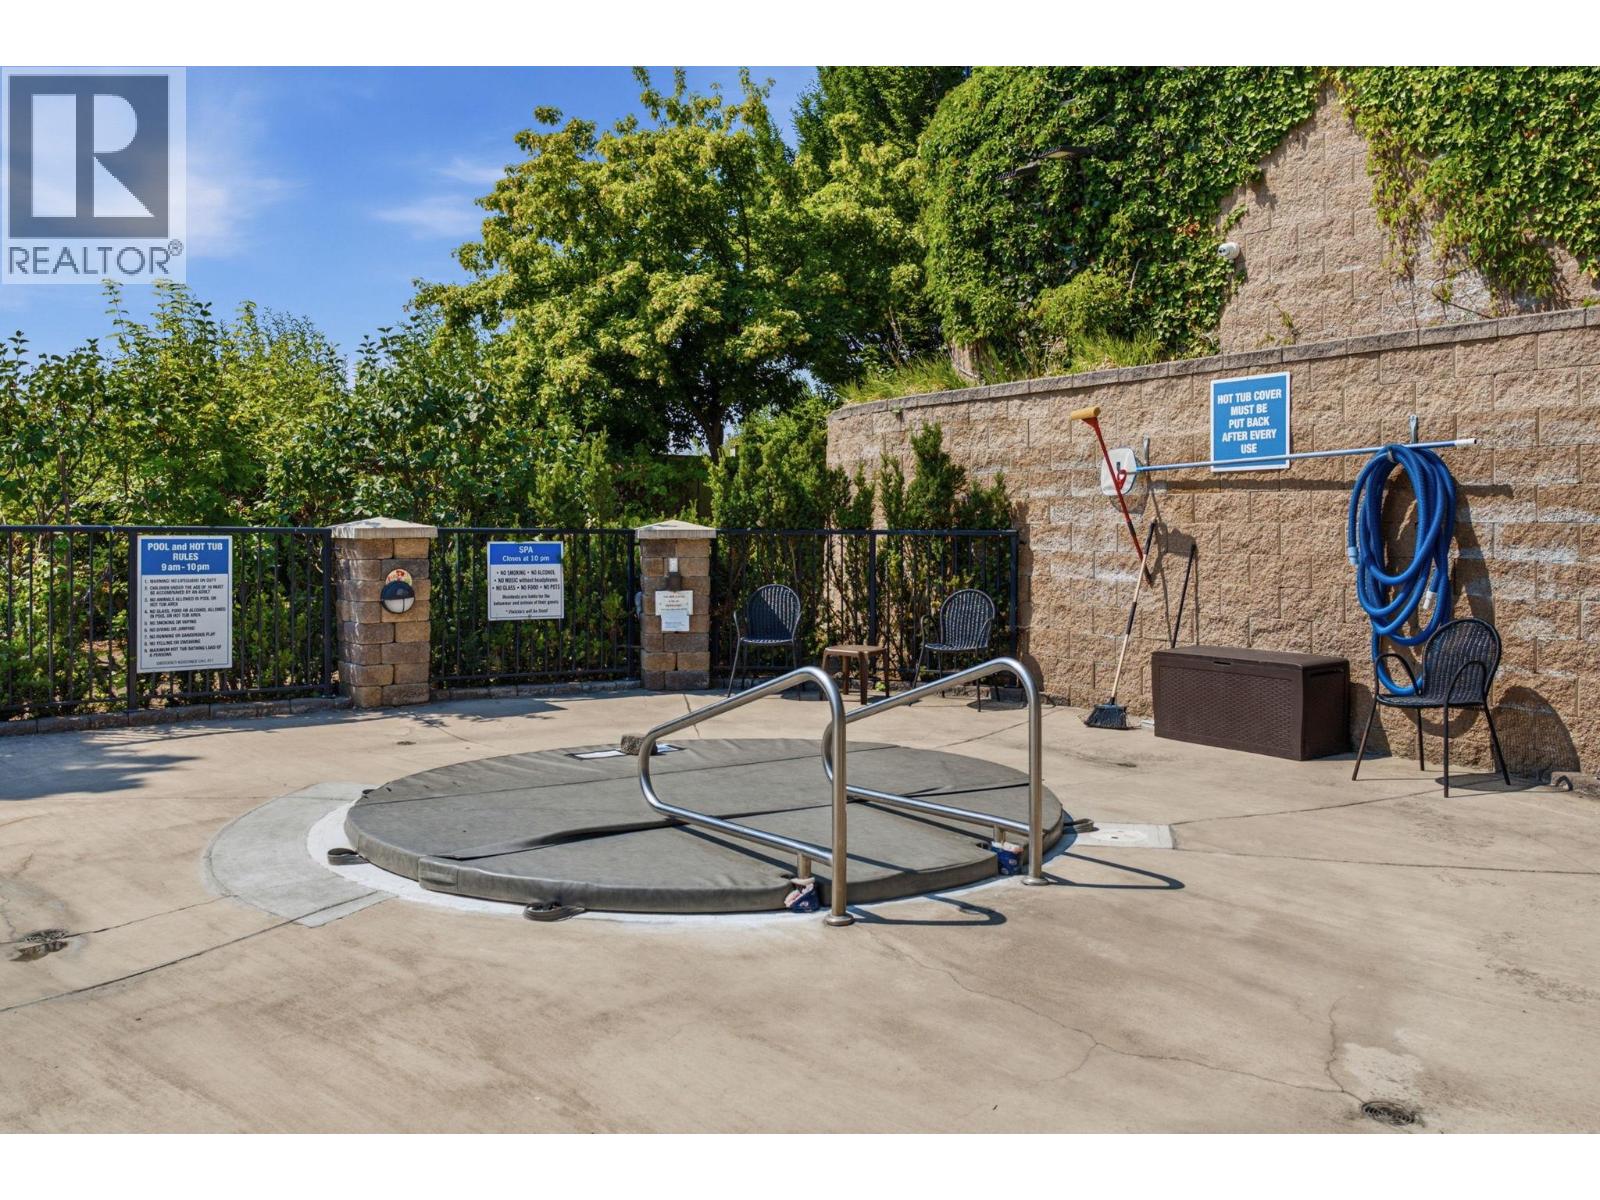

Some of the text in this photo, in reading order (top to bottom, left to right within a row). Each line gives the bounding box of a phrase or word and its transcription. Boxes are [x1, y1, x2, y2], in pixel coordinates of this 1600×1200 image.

[1217, 388, 1282, 405] HOT TUB COVER
[1230, 403, 1268, 416] MUST BE
[1228, 416, 1270, 429] PUT BACK
[1222, 428, 1277, 443] AFTER EVERY
[1240, 443, 1258, 454] USE
[147, 542, 223, 551] POOL and HOT TUB
[518, 545, 534, 554] SPA
[172, 552, 199, 561] RULES
